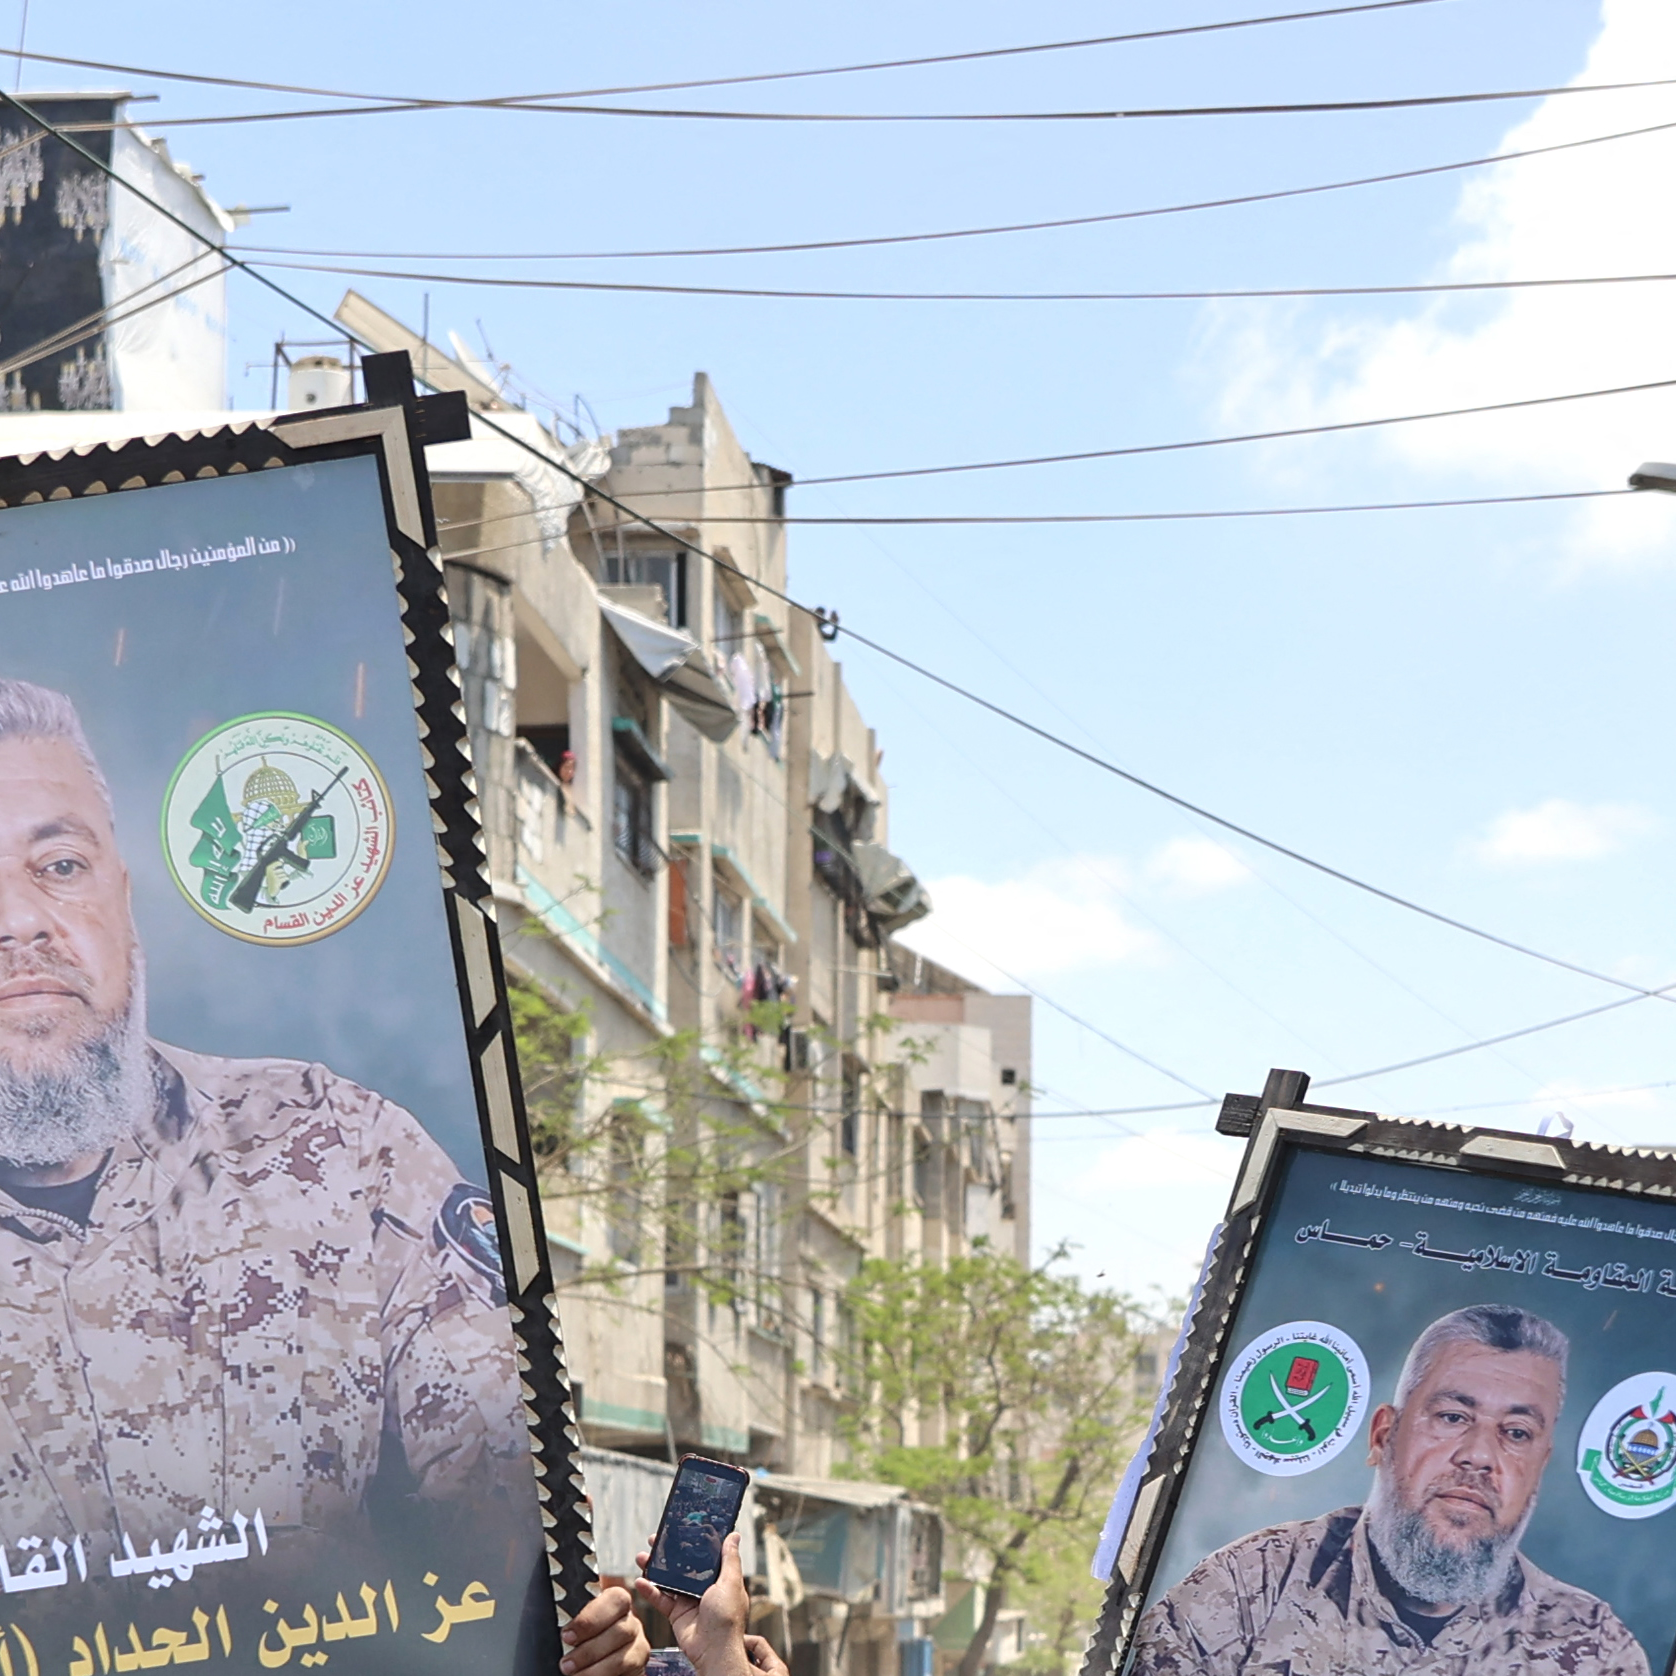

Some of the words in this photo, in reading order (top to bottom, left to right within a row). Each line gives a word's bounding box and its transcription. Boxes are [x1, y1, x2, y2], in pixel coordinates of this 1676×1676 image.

[191, 535, 257, 567] المؤمنين
[258, 539, 281, 555] من
[89, 558, 107, 580] ما
[107, 555, 155, 581] صدقوا
[155, 548, 189, 574] رجال
[11, 568, 35, 592] الله
[37, 563, 88, 591] عاهدوا
[360, 826, 380, 874] الشهيد
[344, 876, 365, 899] عز
[312, 892, 348, 927] الدين
[263, 912, 310, 935] القسام
[1557, 1213, 1578, 1227] عليه
[1594, 1217, 1624, 1234] عاهدوا
[1624, 1222, 1635, 1235] ما
[1635, 1224, 1664, 1240] صدقوا
[1294, 1218, 1393, 1252] حماس
[1542, 1252, 1654, 1294] المقاومة
[110, 1503, 269, 1590] الشهيد
[422, 1572, 497, 1644] عز
[257, 1580, 399, 1669] الدين
